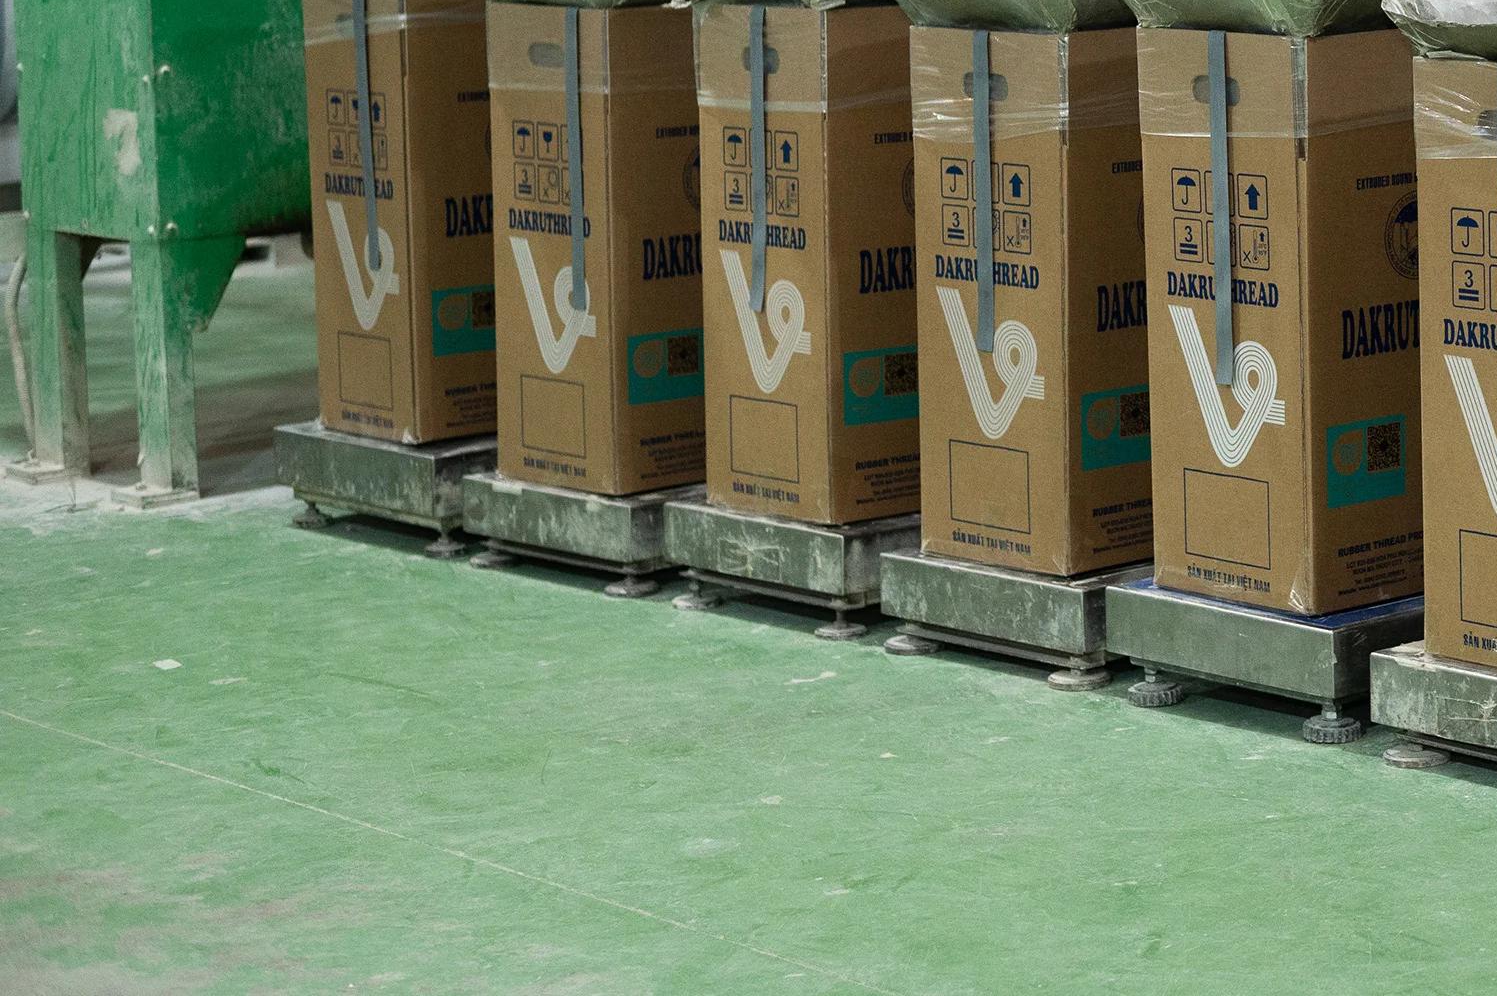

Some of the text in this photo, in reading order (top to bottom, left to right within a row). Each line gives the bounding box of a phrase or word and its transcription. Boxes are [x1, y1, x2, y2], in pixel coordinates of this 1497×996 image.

[733, 178, 739, 193] 3
[952, 212, 960, 227] 3
[1184, 225, 1193, 242] 3
[1464, 270, 1474, 288] 3
